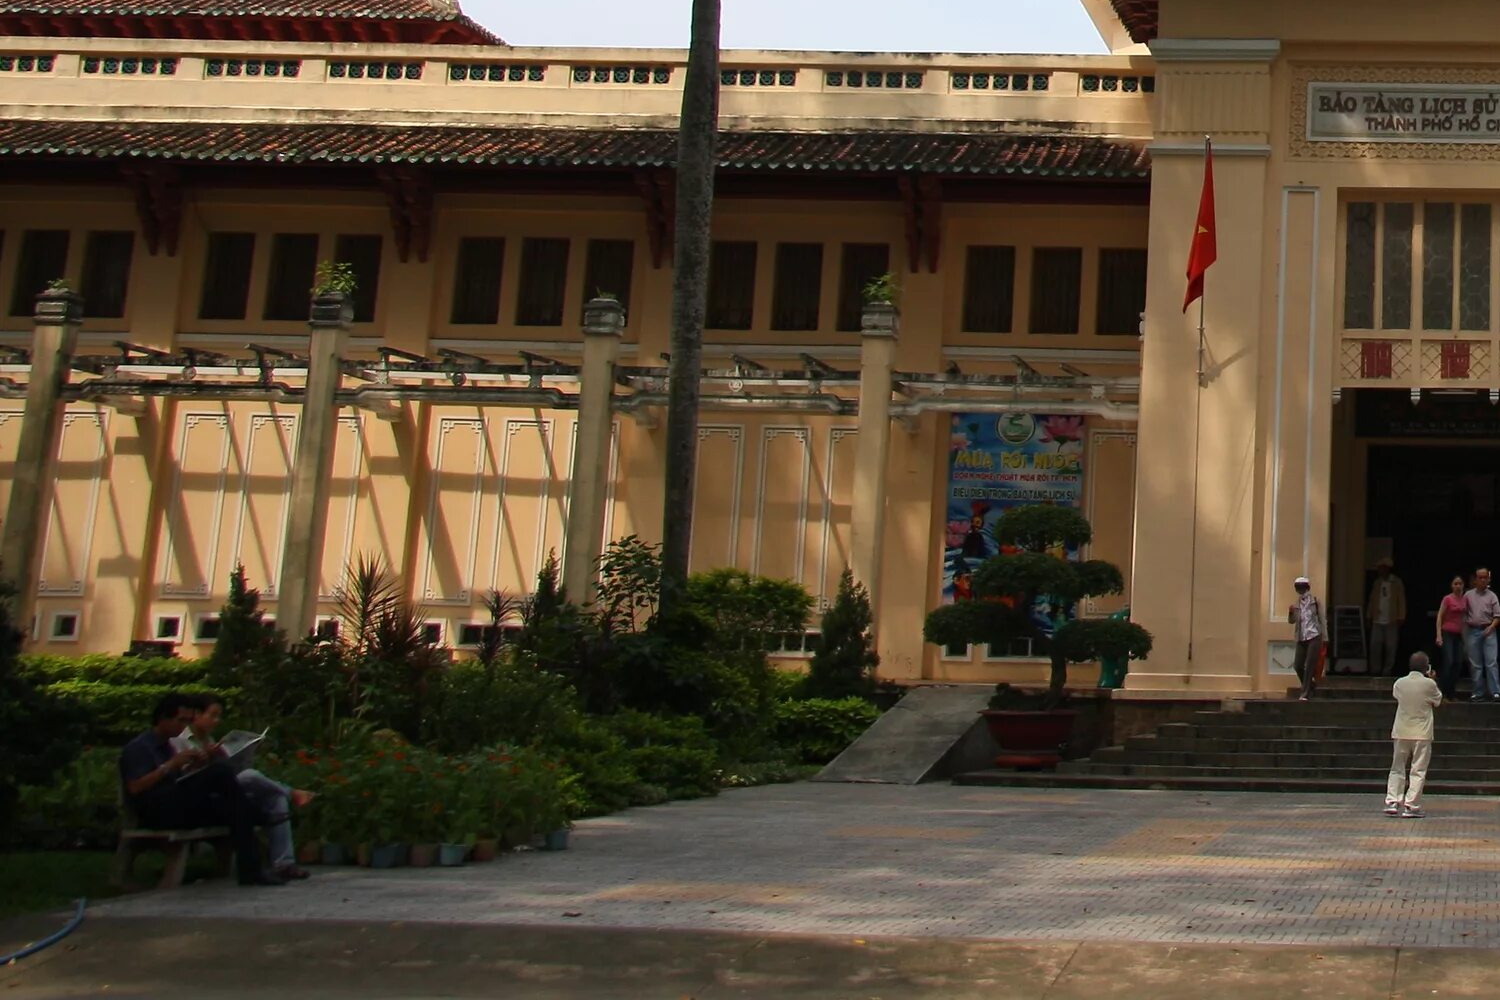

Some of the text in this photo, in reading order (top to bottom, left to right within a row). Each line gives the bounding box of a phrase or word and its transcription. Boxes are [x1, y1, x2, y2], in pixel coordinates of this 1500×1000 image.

[1319, 91, 1358, 113] BẢO
[1363, 91, 1415, 114] TÀNG
[1419, 97, 1467, 118] LỊCH
[1473, 93, 1499, 115] SỬ
[1365, 113, 1417, 132] THÀNH
[1422, 112, 1454, 131] PHỐ
[1458, 114, 1481, 132] HỒ
